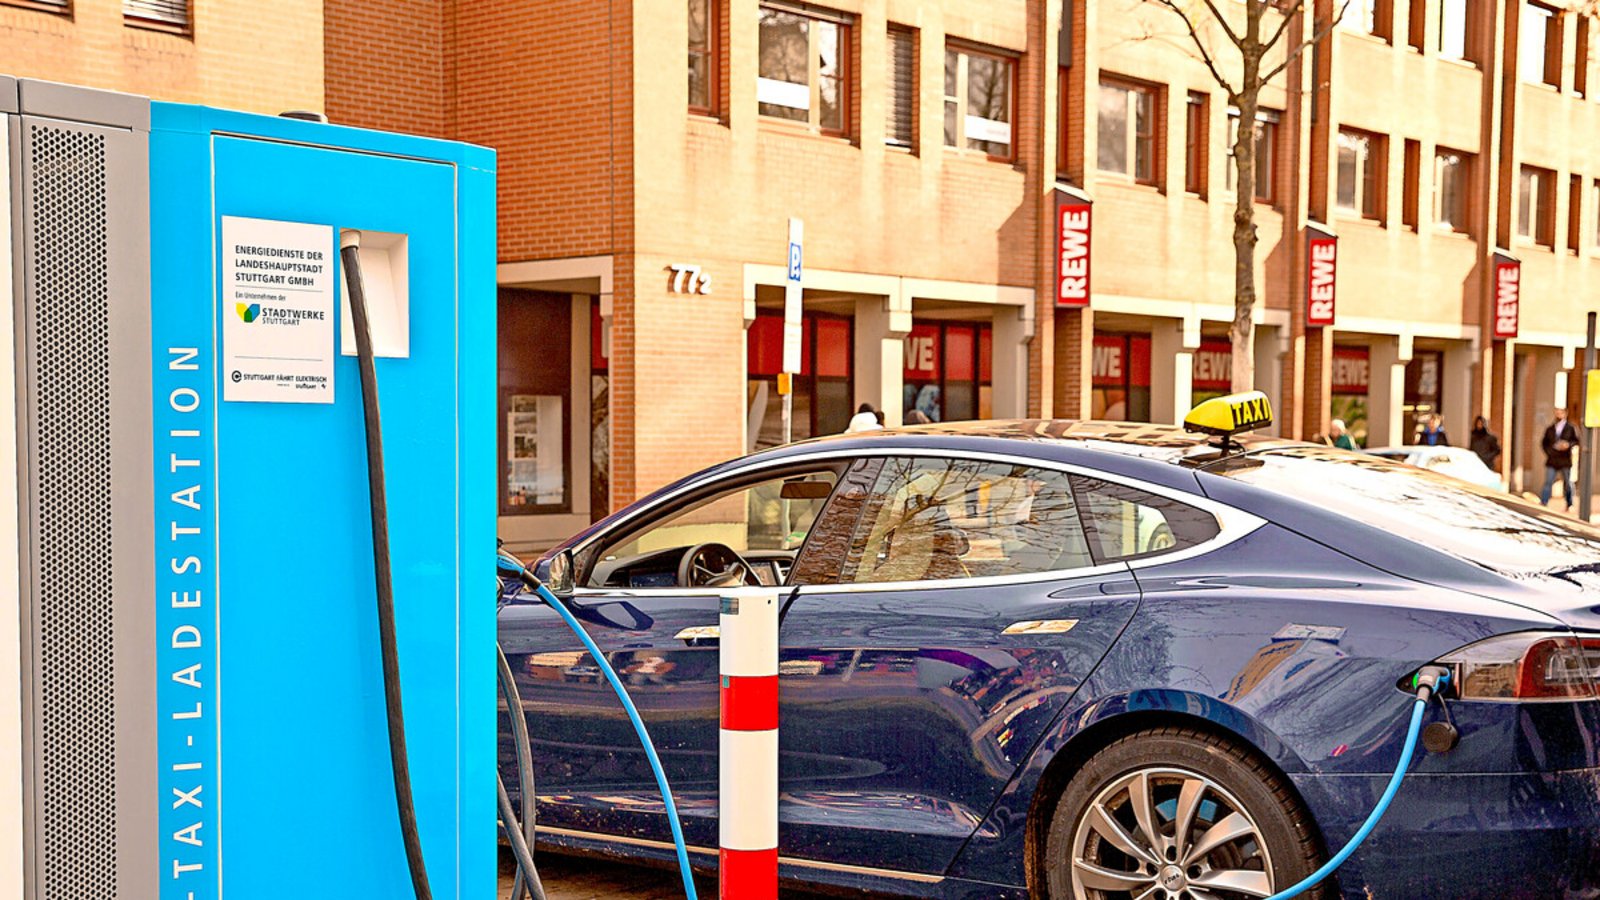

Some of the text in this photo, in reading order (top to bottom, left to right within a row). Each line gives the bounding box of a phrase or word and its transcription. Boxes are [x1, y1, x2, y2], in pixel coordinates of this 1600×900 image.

[235, 245, 323, 260] ENERGIEDIENSTE DER
[1061, 210, 1088, 298] REWE
[235, 259, 323, 273] LANDESHAUPTSTADT
[235, 272, 314, 286] STUTTGART GMBH
[1310, 244, 1335, 319] REWE
[1496, 268, 1518, 333] REWE
[262, 308, 325, 320] STADTWERKE
[262, 317, 300, 325] STUTTGART
[1093, 346, 1121, 378] WE
[243, 373, 275, 381] STUTTGART
[1232, 397, 1269, 425] TAXI
